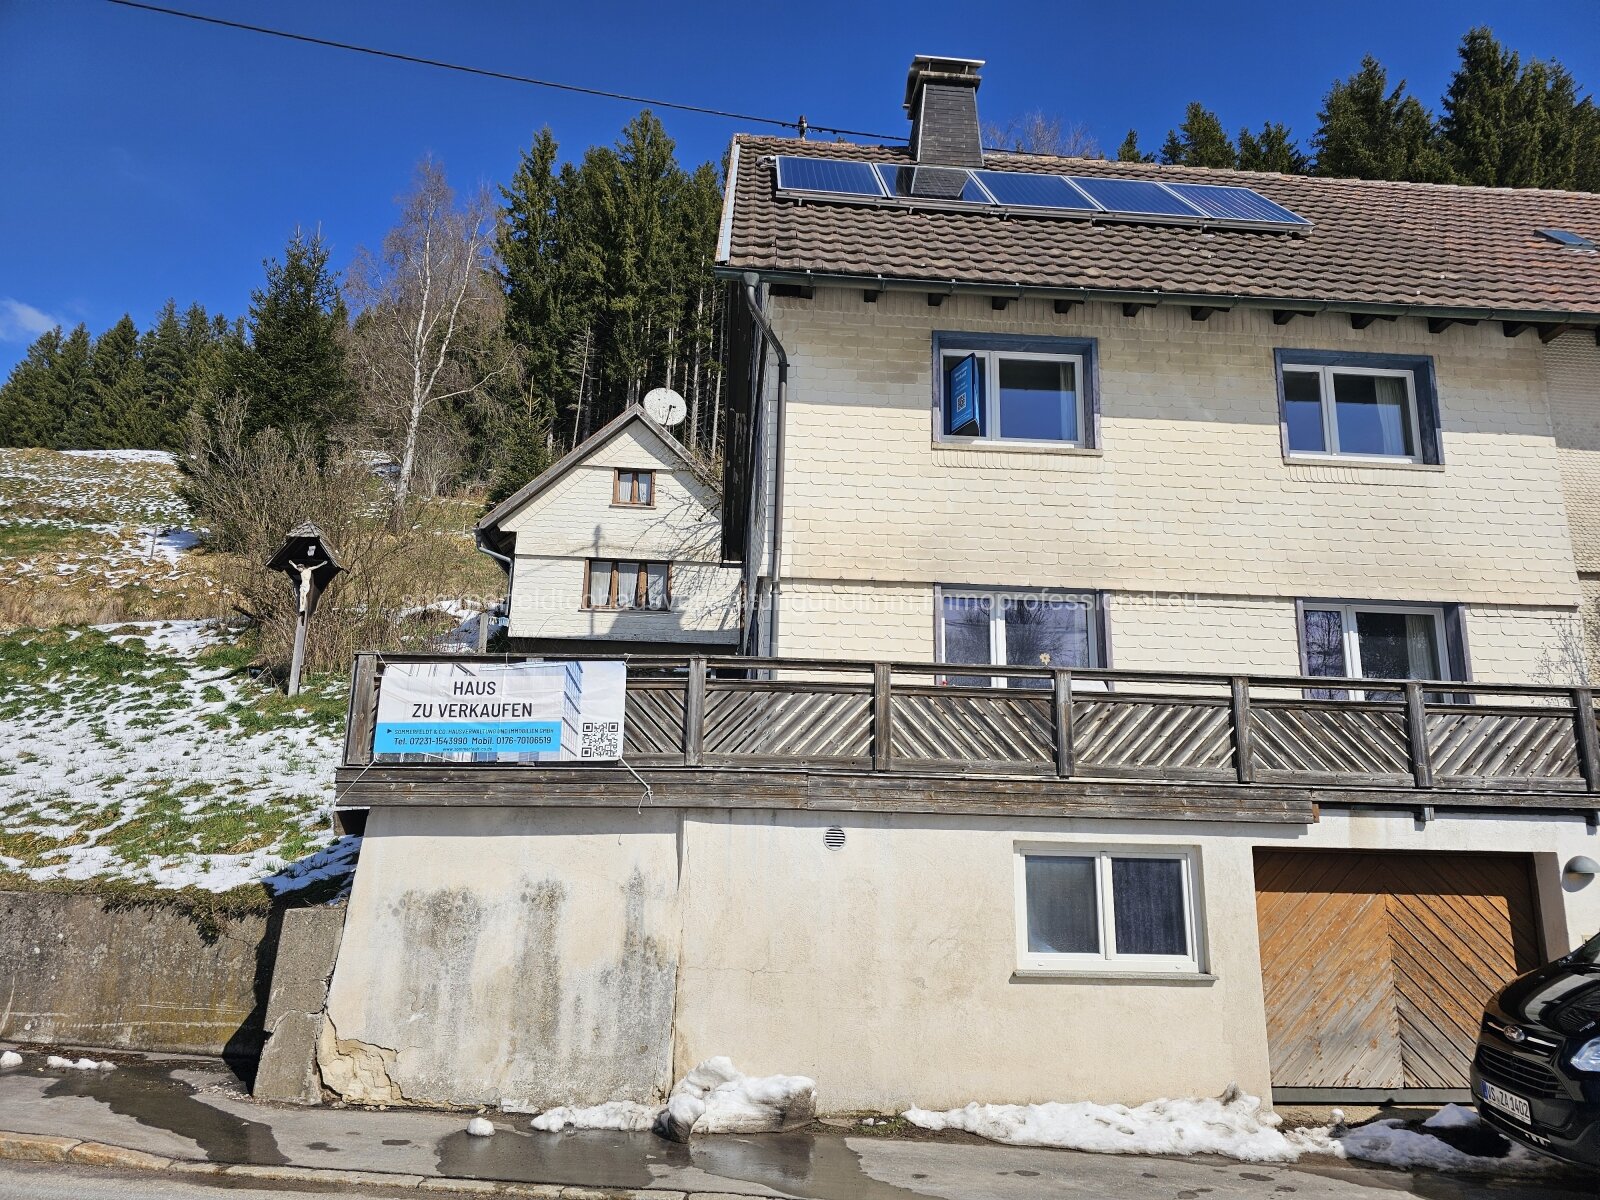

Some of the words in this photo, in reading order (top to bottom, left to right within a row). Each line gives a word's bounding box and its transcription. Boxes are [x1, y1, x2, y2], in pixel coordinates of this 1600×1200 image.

[453, 681, 496, 695] HAUS
[412, 703, 433, 718] ZU
[438, 703, 532, 717] VERKAUFEN
[394, 737, 407, 745] Tel.
[409, 737, 468, 745] 07231-1543990
[471, 737, 494, 745] Mobil.
[496, 736, 552, 745] 0176-70106519
[1499, 1090, 1510, 1109] ZA
